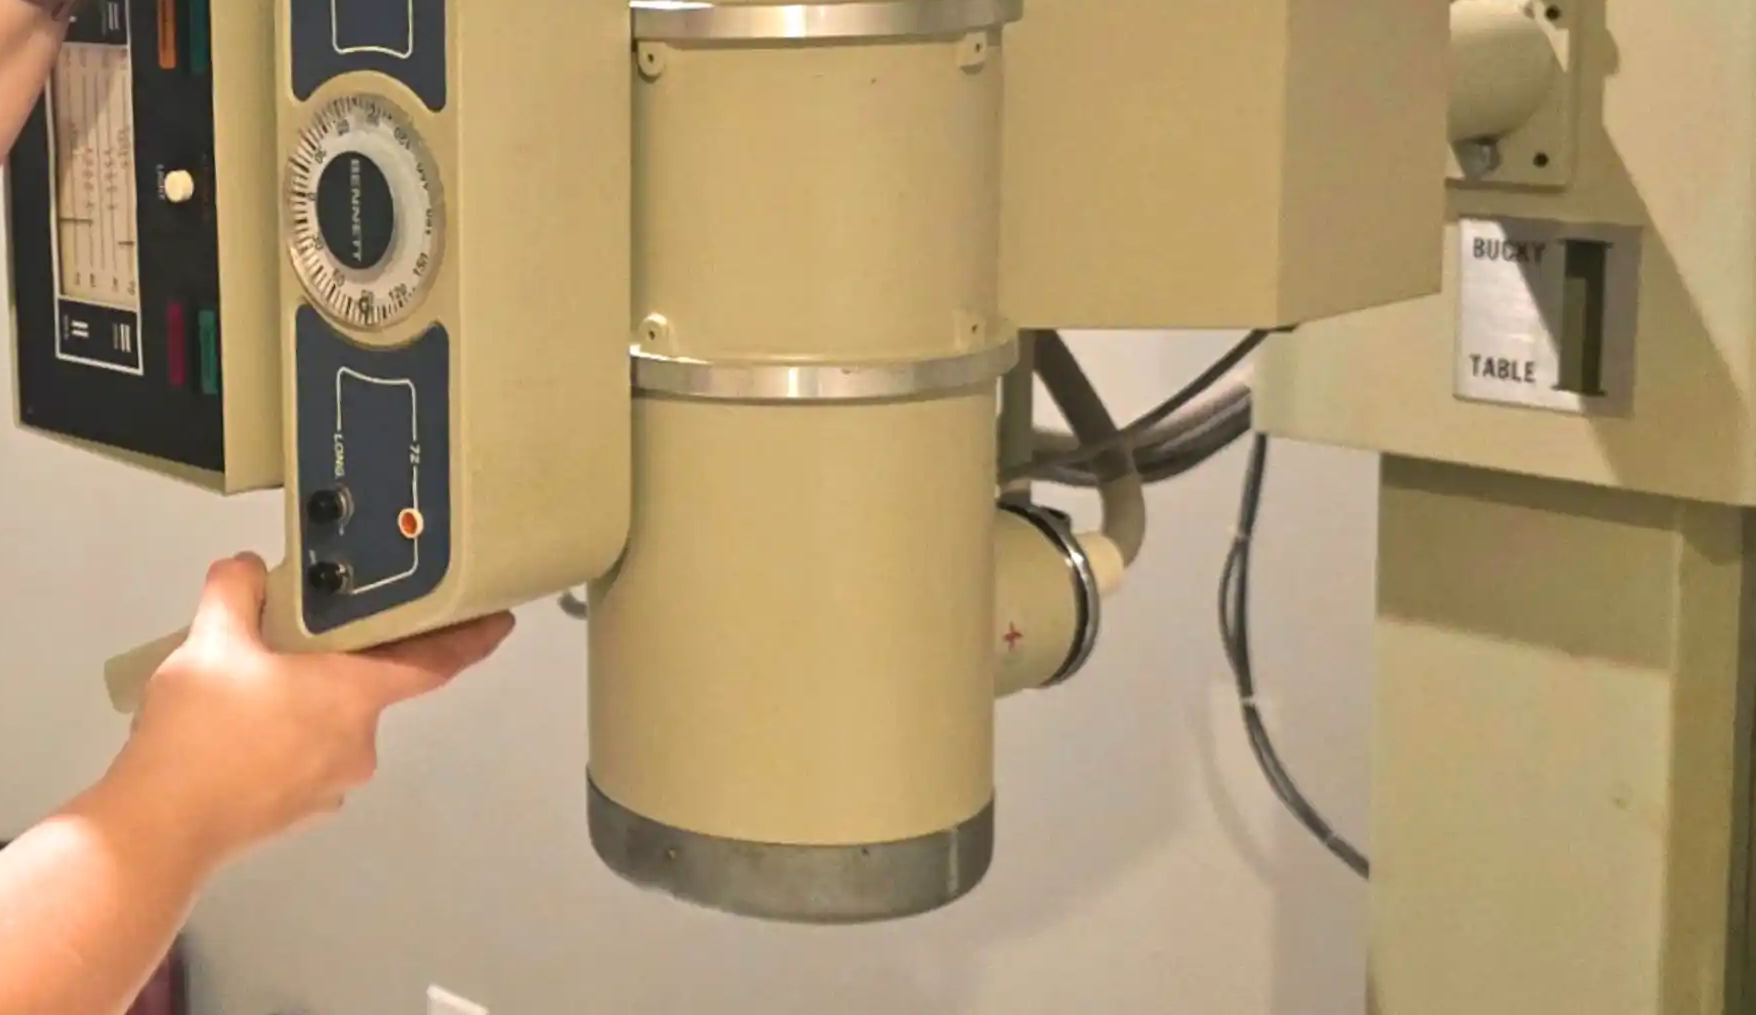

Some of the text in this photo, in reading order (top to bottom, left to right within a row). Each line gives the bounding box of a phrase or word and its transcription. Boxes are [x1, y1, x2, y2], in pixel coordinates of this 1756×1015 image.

[349, 158, 363, 263] BENNETT
[1472, 236, 1547, 265] BUCKY
[1469, 353, 1537, 384] TABLE
[409, 443, 421, 465] 72
